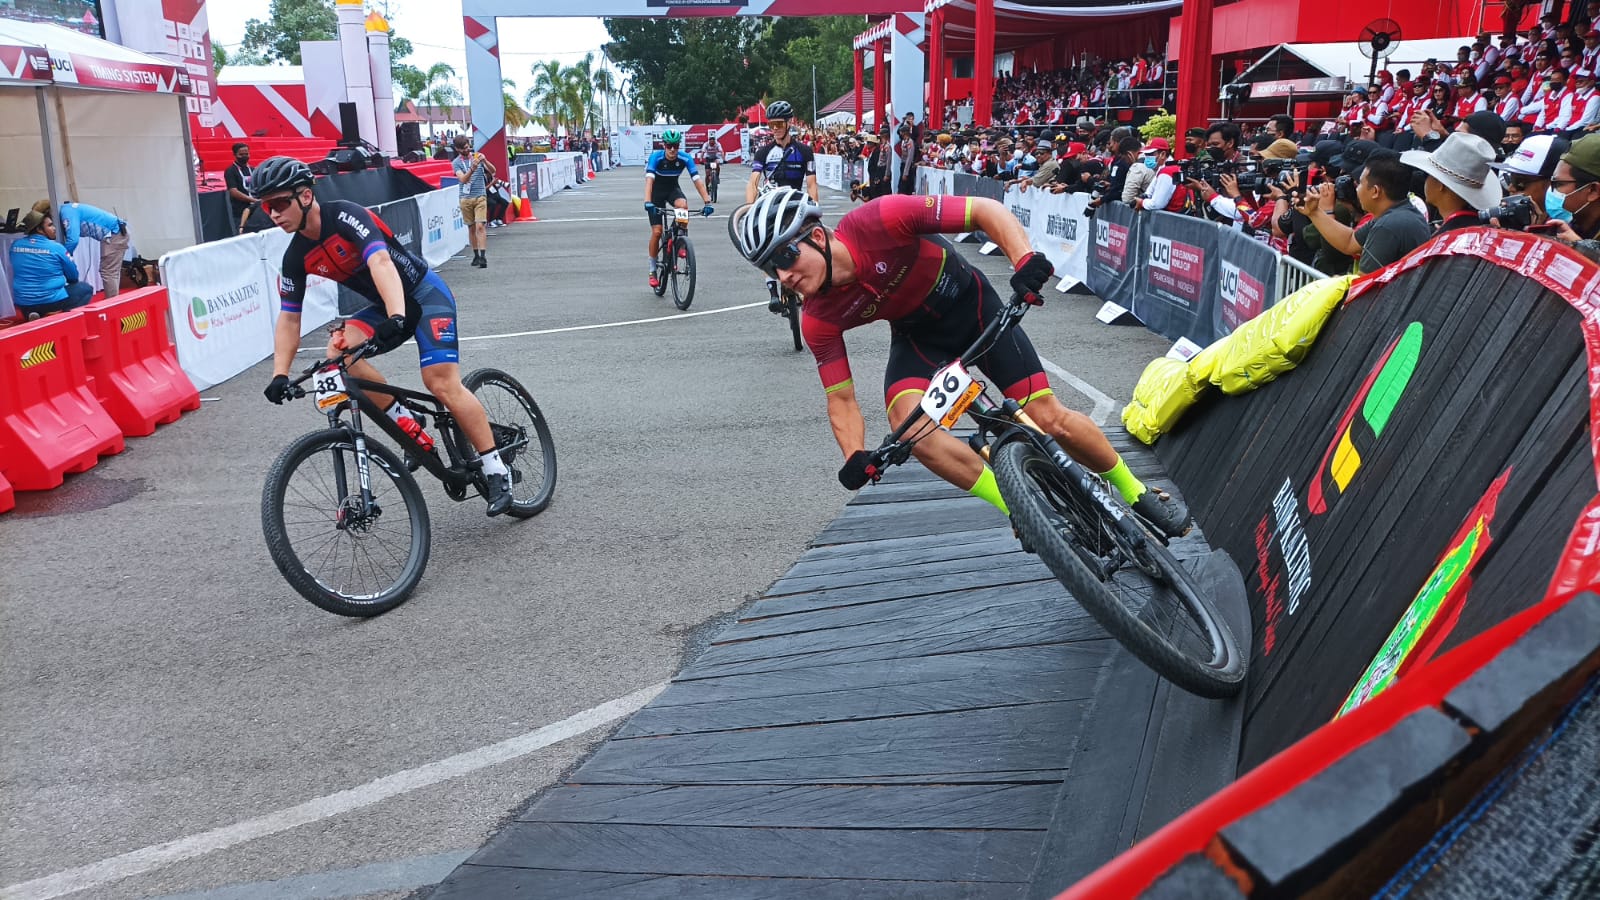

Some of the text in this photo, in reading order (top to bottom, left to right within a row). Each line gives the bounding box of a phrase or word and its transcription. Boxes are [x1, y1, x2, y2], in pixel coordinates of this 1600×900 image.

[54, 59, 73, 72] UCI
[89, 64, 158, 85] TIMING SYSTEM
[338, 211, 370, 238] PLIMAB
[427, 215, 444, 230] GoPro
[1152, 241, 1170, 265] UCI
[1222, 267, 1238, 297] UCI
[207, 296, 230, 314] BANK
[229, 282, 259, 305] KALTENG
[317, 376, 338, 395] 38
[928, 371, 960, 409] 36
[357, 452, 370, 490] SID
[1272, 476, 1311, 616] BANK KALTENG
